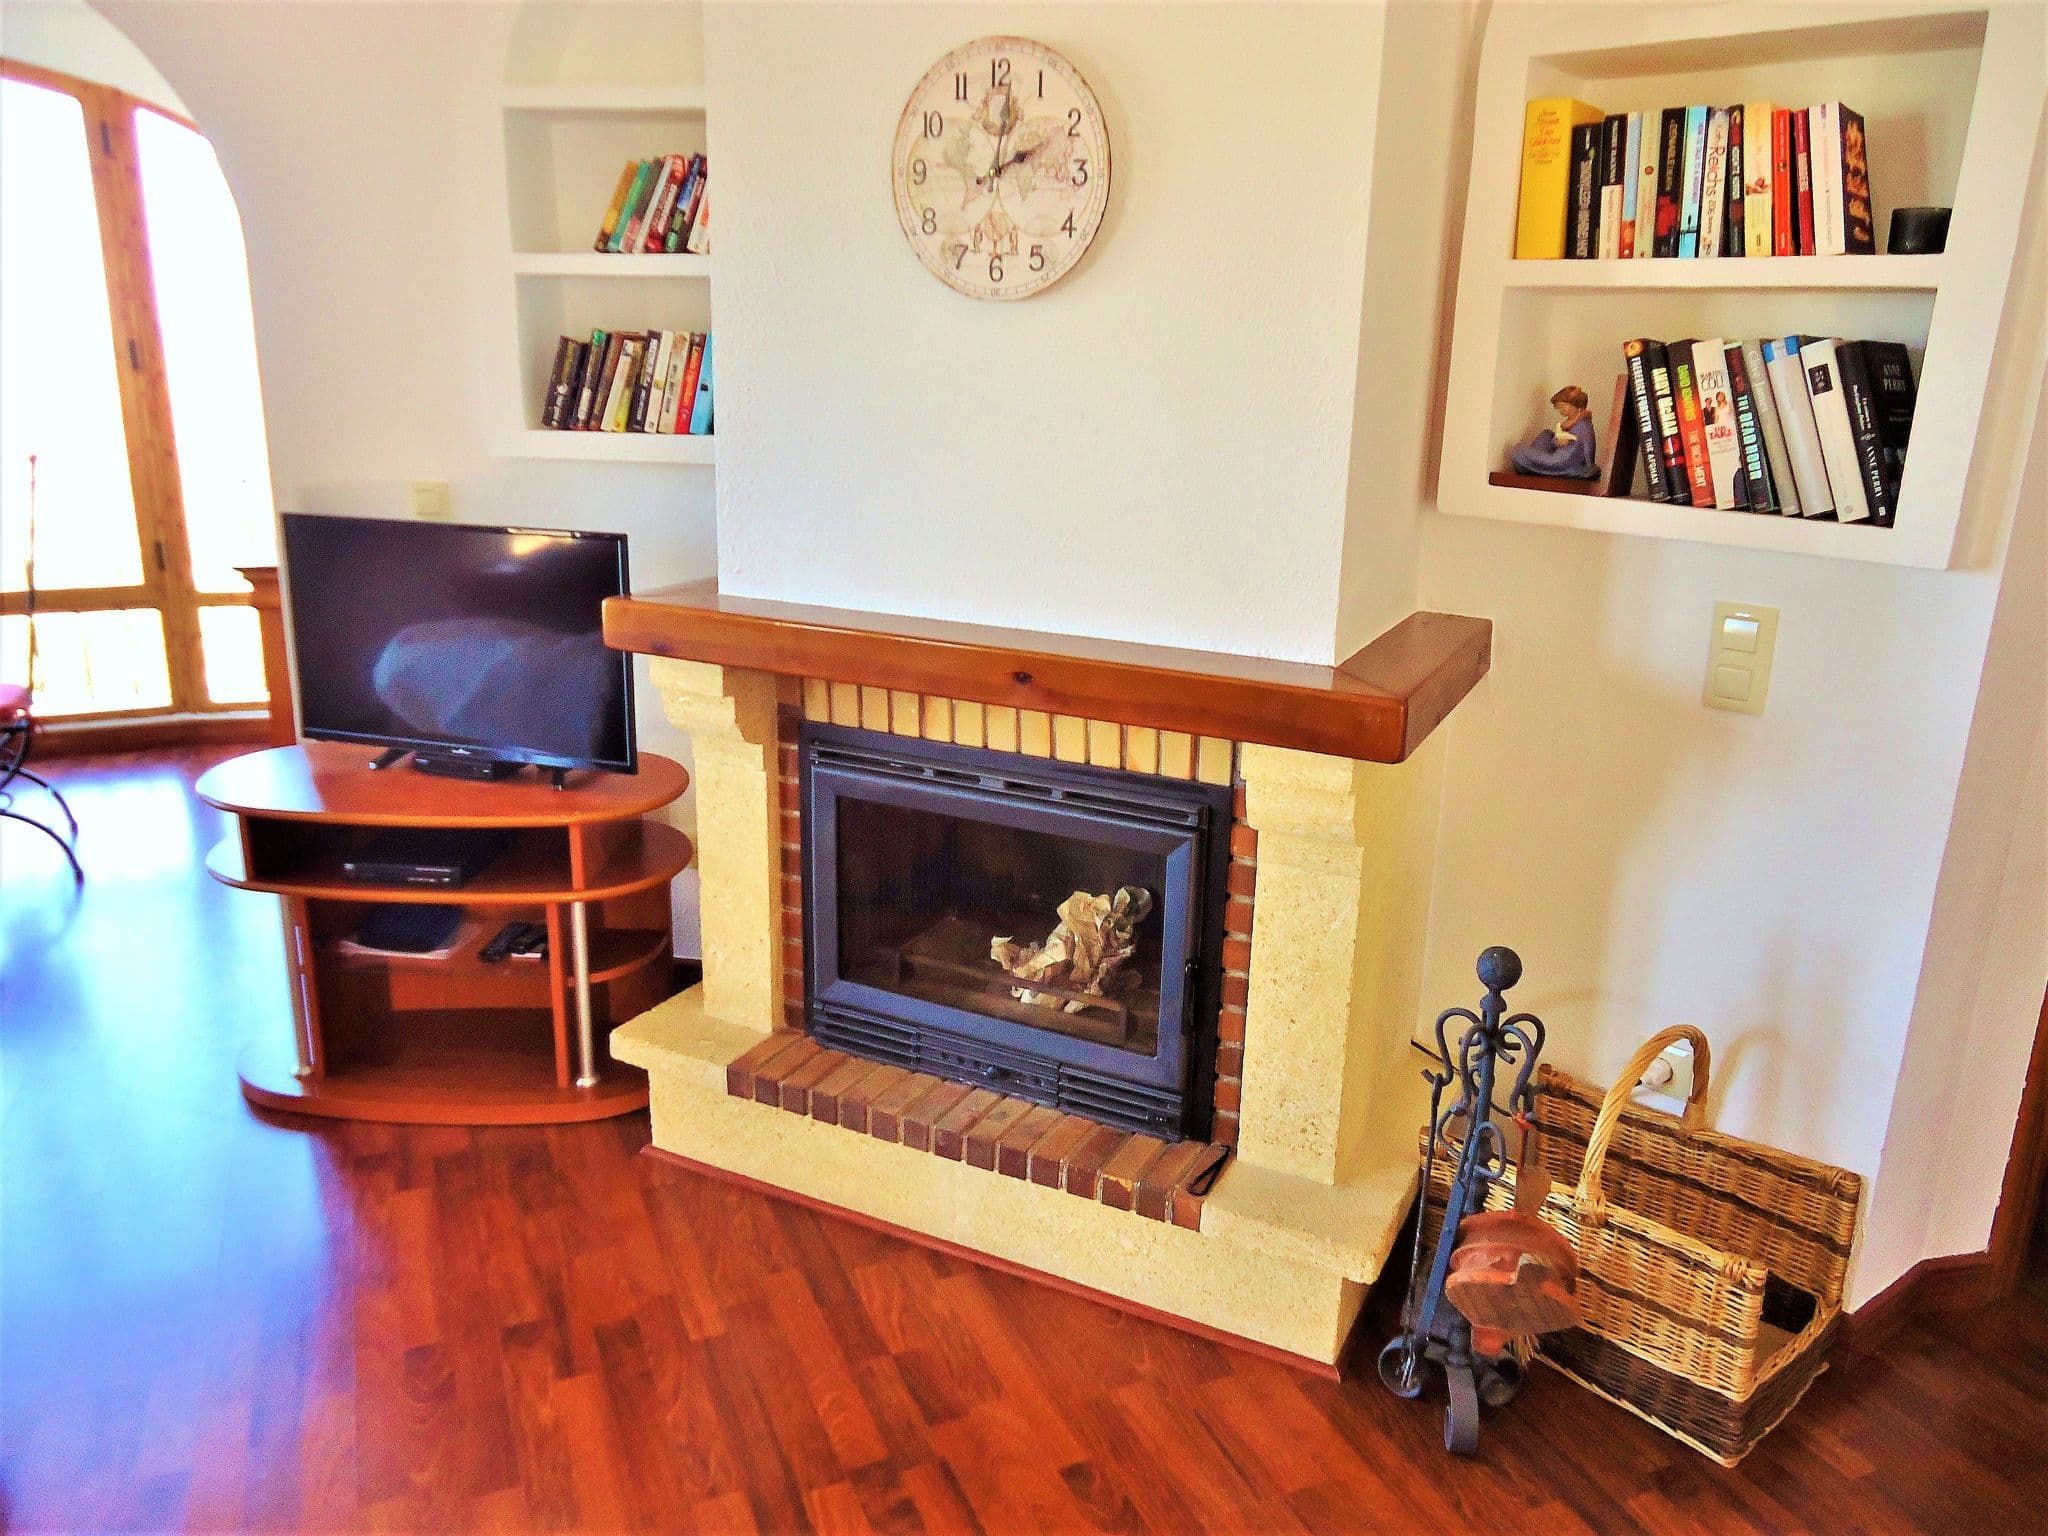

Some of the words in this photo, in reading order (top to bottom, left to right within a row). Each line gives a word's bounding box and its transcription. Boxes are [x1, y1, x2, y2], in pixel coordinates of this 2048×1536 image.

[956, 72, 967, 100] 11
[991, 57, 1011, 88] 12
[1038, 69, 1043, 98] 1
[923, 111, 943, 138] 10
[1067, 108, 1082, 137] 2
[912, 159, 927, 185] 9
[1071, 159, 1088, 187] 3
[1705, 145, 1725, 196] Reichs
[921, 207, 937, 235] 8
[1061, 210, 1078, 238] 4
[954, 244, 969, 270] 7
[989, 255, 1003, 282] 6
[1029, 245, 1044, 271] 5
[1630, 356, 1646, 395] FREDERICK
[1636, 394, 1652, 432] FORSYTH
[1736, 394, 1749, 411] THE
[1687, 429, 1699, 444] THE
[1738, 411, 1757, 445] DEAD
[1644, 437, 1654, 451] THE
[1865, 445, 1877, 468] ANNE
[1646, 453, 1659, 484] AFGHAN
[1744, 443, 1763, 480] HOUR
[1870, 469, 1883, 498] PERRY
